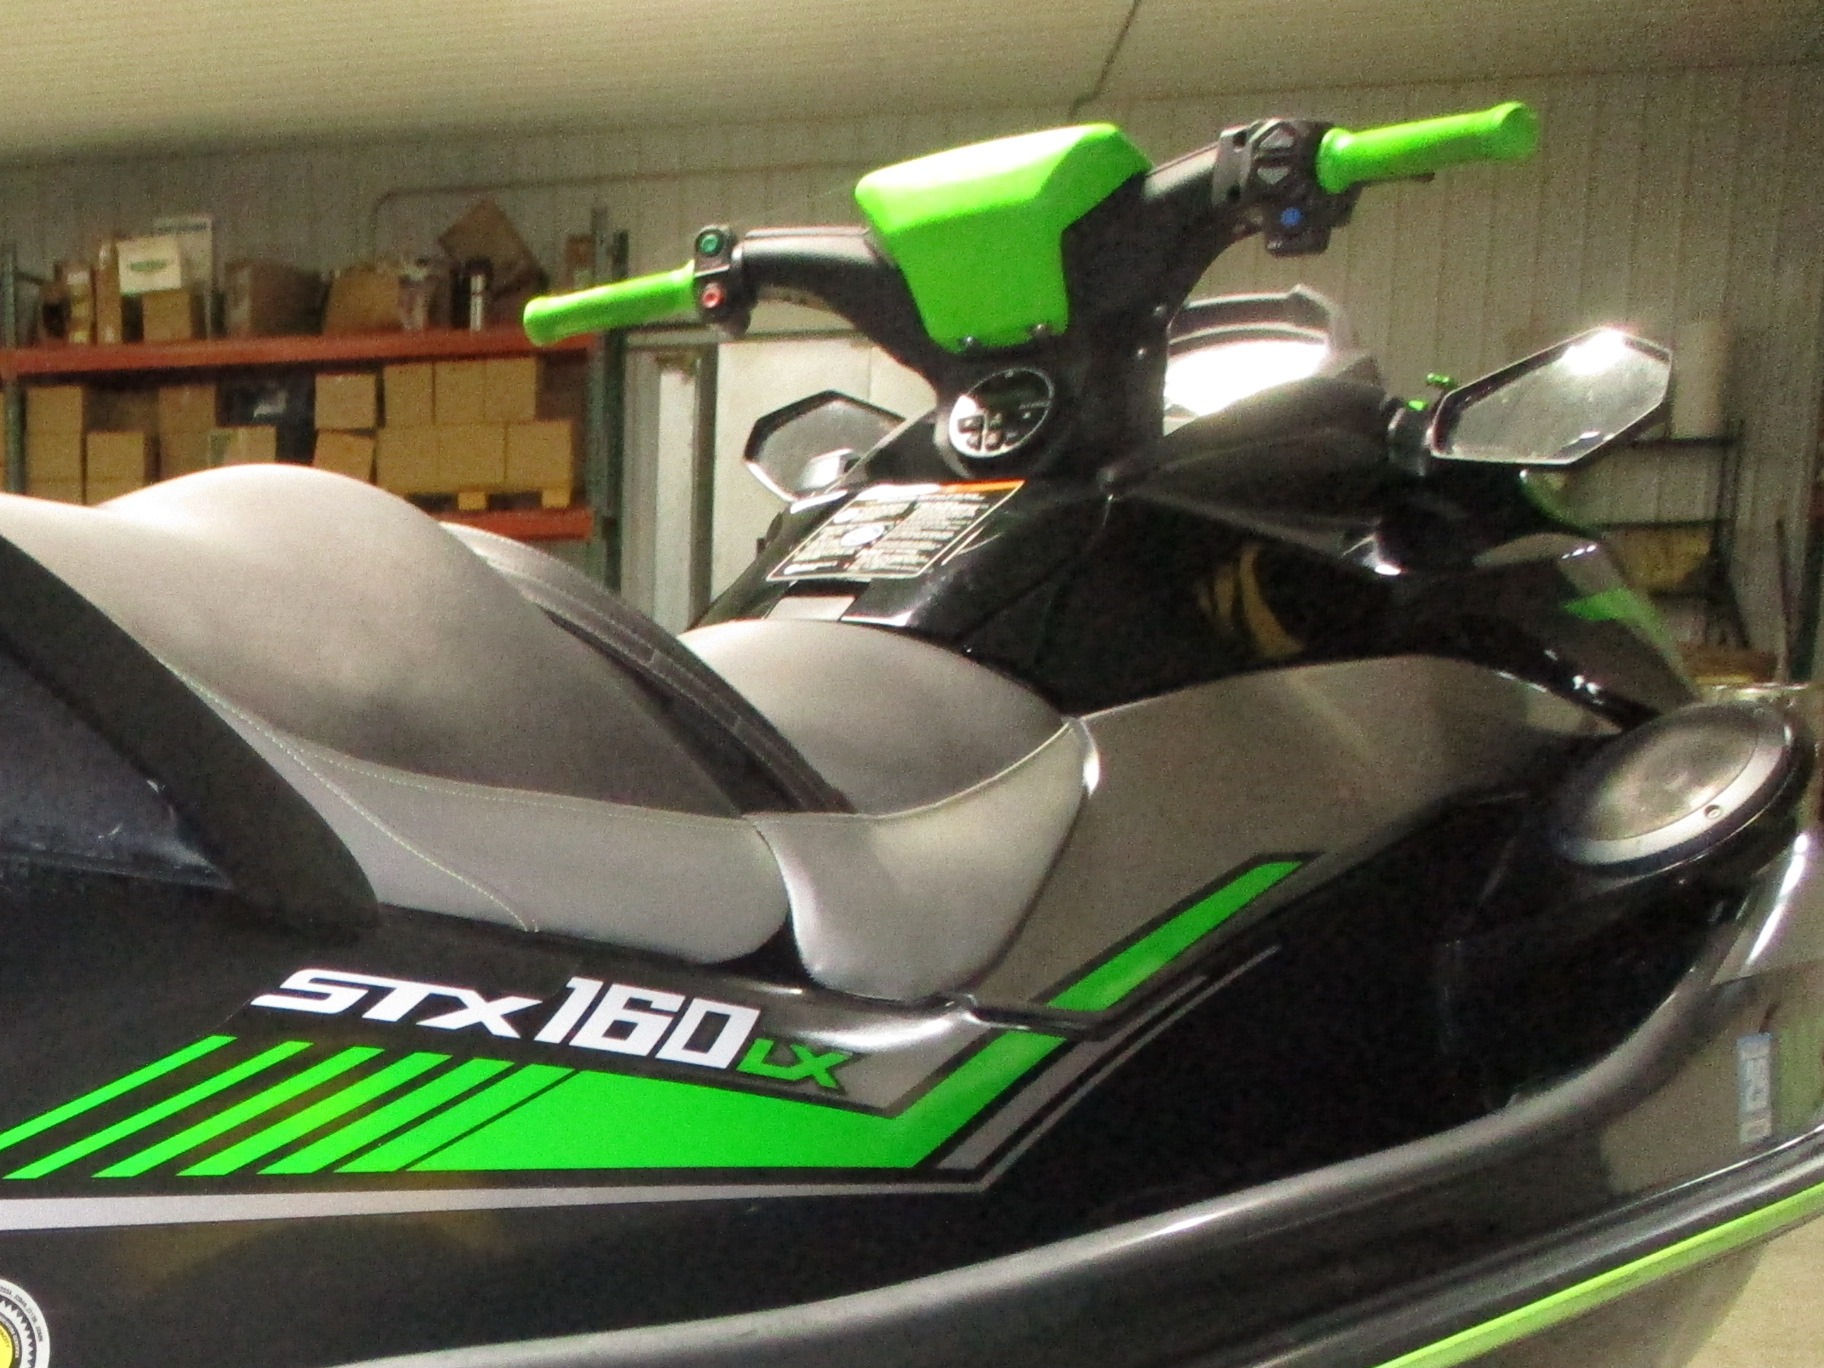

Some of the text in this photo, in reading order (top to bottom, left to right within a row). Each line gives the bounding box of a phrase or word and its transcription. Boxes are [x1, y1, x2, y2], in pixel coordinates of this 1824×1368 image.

[250, 968, 852, 1090] STX 160 LX
